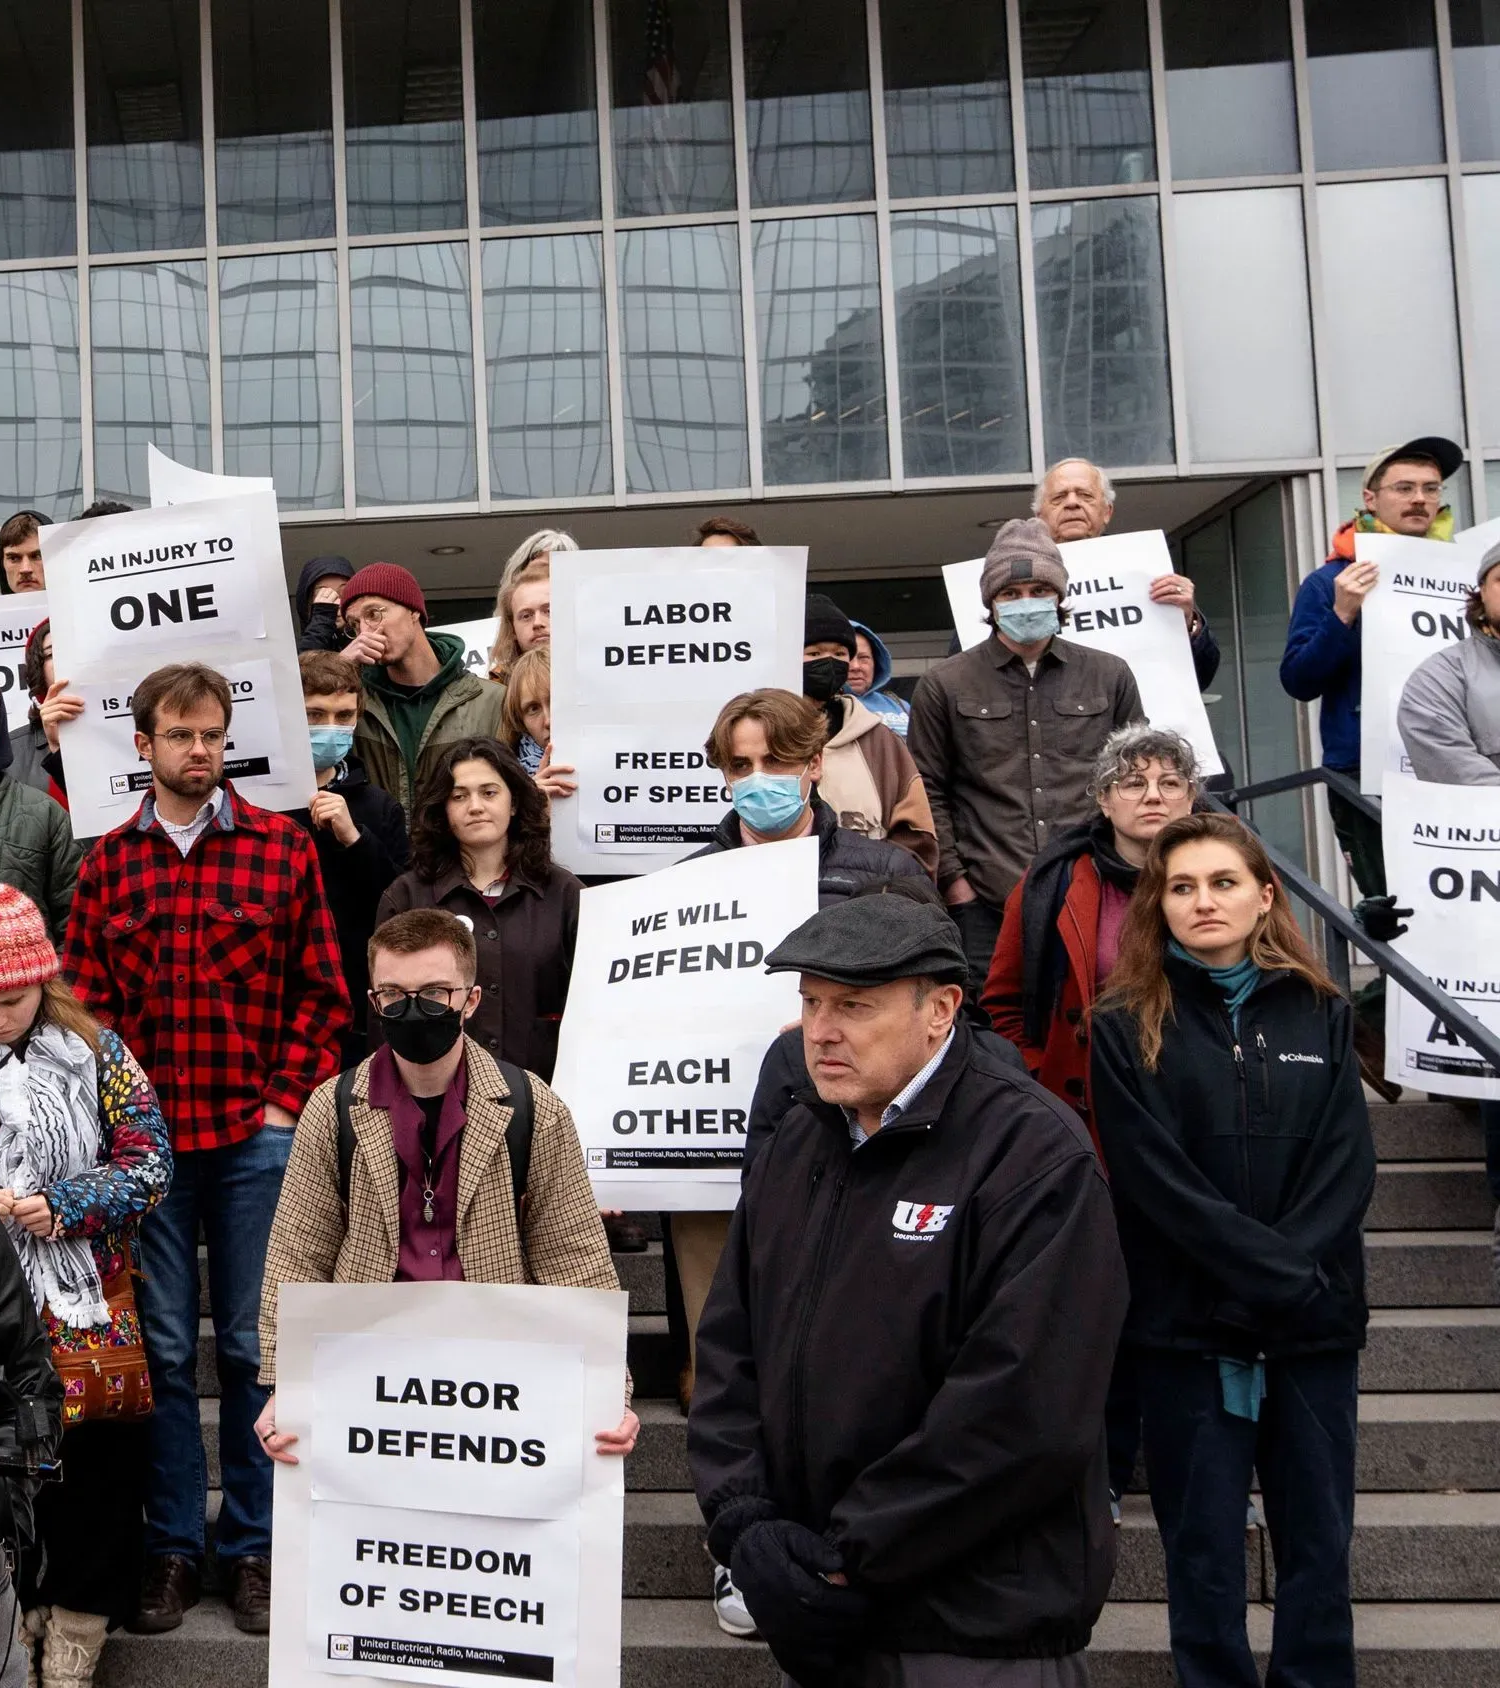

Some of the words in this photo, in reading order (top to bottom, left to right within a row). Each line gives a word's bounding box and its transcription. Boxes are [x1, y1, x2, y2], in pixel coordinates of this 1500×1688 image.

[88, 555, 114, 574] AN
[122, 543, 197, 568] INJURY
[204, 537, 233, 554] TO
[1393, 573, 1414, 587] AN
[110, 584, 218, 630] ONE
[624, 602, 732, 627] LABOR
[1065, 605, 1143, 633] END
[1411, 610, 1465, 640] ON
[604, 641, 752, 667] DEFENDS
[229, 681, 253, 694] TO
[102, 698, 119, 710] IS
[615, 752, 718, 770] FREED
[603, 785, 639, 803] OF
[648, 785, 733, 803] SPEEC
[643, 826, 677, 834] Electrical,
[678, 826, 699, 834] Radio,
[1413, 822, 1438, 839] AN
[1448, 827, 1500, 842] INJU
[1429, 867, 1500, 902] ON
[631, 911, 669, 937] WE
[677, 900, 748, 927] WILL
[607, 940, 764, 984] DEFEND
[1456, 980, 1500, 993] INJU
[1287, 1053, 1324, 1064] Columbia
[627, 1058, 731, 1086] EACH
[612, 1108, 748, 1135] OTHER
[686, 1151, 716, 1159] Machine,
[892, 1200, 955, 1232] UE
[375, 1375, 520, 1411] LABOR
[348, 1427, 546, 1467] DEFENDS
[356, 1538, 531, 1578] FREEDOM
[339, 1582, 387, 1608] OF
[399, 1588, 545, 1626] SPEECH
[360, 1651, 395, 1662] Workers
[397, 1655, 407, 1663] of
[408, 1656, 444, 1668] America
[361, 1638, 389, 1650] United
[391, 1642, 434, 1655] Electrical,
[436, 1646, 463, 1658] Radio,
[466, 1650, 505, 1663] Machine,
